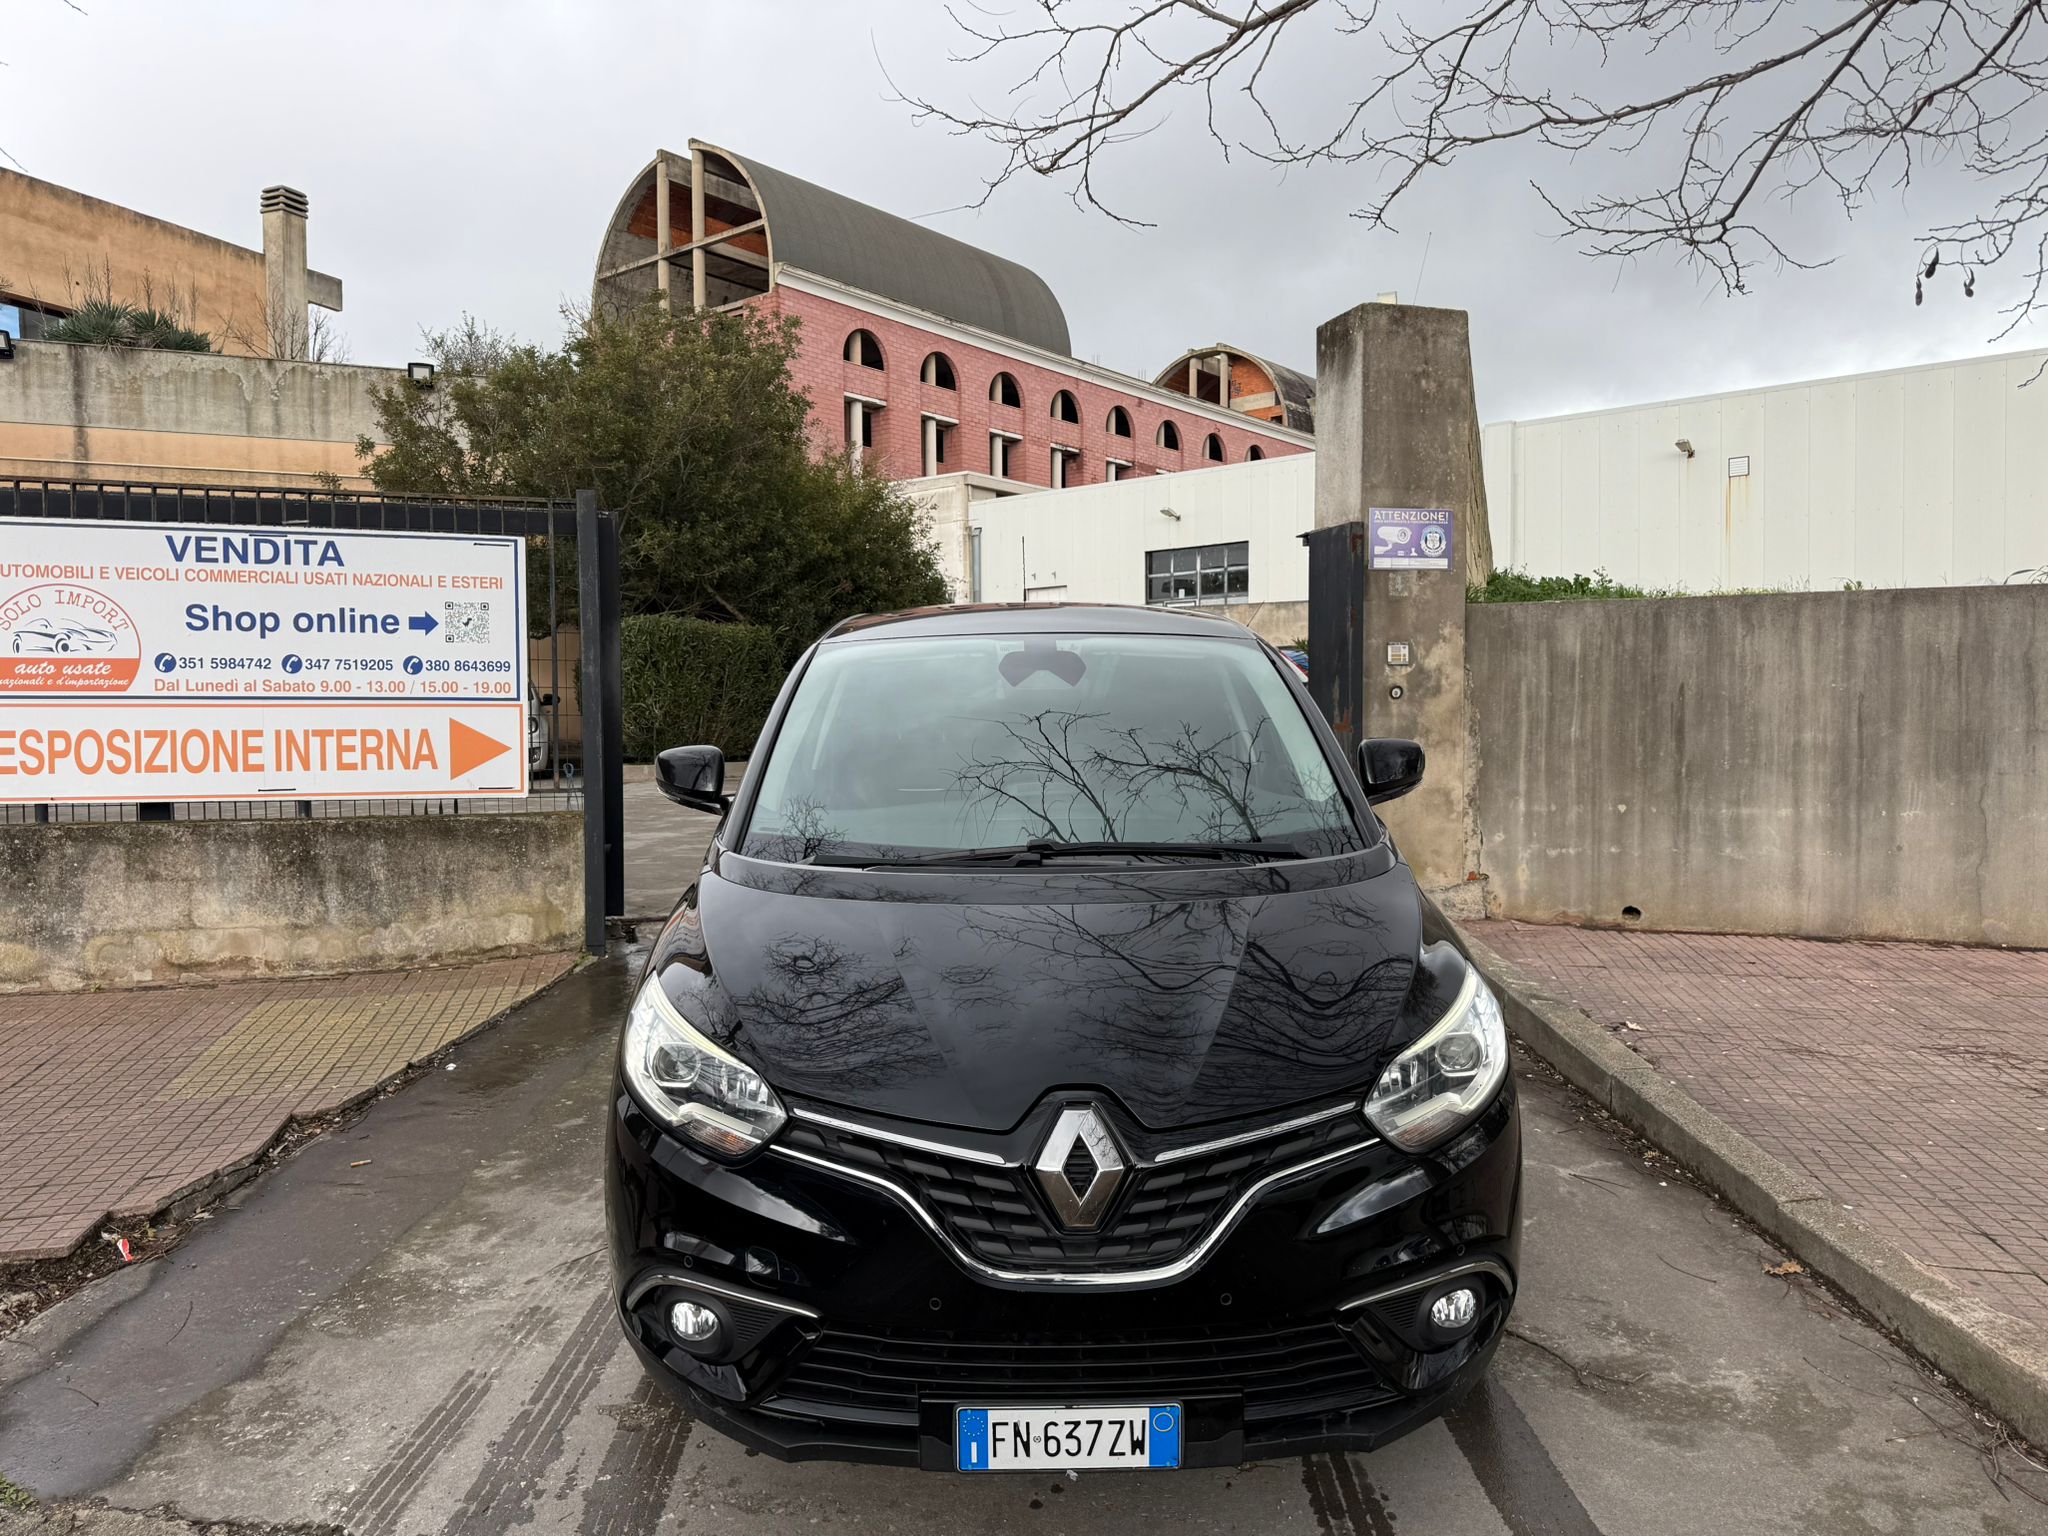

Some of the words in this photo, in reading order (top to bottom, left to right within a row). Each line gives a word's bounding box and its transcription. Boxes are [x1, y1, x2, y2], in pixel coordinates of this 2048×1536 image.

[1374, 510, 1449, 521] ATTENZIONE!
[165, 535, 344, 567] VENDITA
[0, 564, 94, 580] UTOMOBILI
[100, 567, 110, 580] E
[115, 567, 179, 582] VEICOLI
[184, 569, 298, 584] COMMERCIALI
[304, 572, 347, 586] USATI
[352, 573, 433, 588] NAZIONALI
[438, 576, 447, 588] E
[451, 576, 503, 590] ESTERI
[0, 593, 42, 631] SOLO
[55, 589, 130, 631] IMPORT
[185, 604, 281, 639] Shop
[293, 607, 401, 635] online
[15, 661, 57, 675] auto
[62, 661, 112, 675] usate
[179, 657, 204, 669] 351
[210, 657, 272, 670] 5984742
[305, 659, 330, 670] 347
[335, 659, 394, 671] 7519205
[425, 660, 450, 672] 380
[454, 660, 511, 673] 8643699
[47, 678, 54, 686] e
[56, 675, 129, 688] d'importazione
[154, 679, 179, 692] Dal
[186, 679, 239, 692] Lunedì
[244, 680, 257, 692] al
[262, 680, 316, 693] Sabato
[320, 680, 351, 693] 9.00
[367, 681, 406, 693] 13.00
[409, 680, 416, 694] /
[420, 682, 459, 694] 15.00
[473, 682, 511, 694] 19.00
[0, 728, 265, 775] ESPOSIZIONE
[274, 728, 439, 772] INTERNA
[992, 1421, 1031, 1458] FN
[1044, 1420, 1146, 1458] 637ZW
